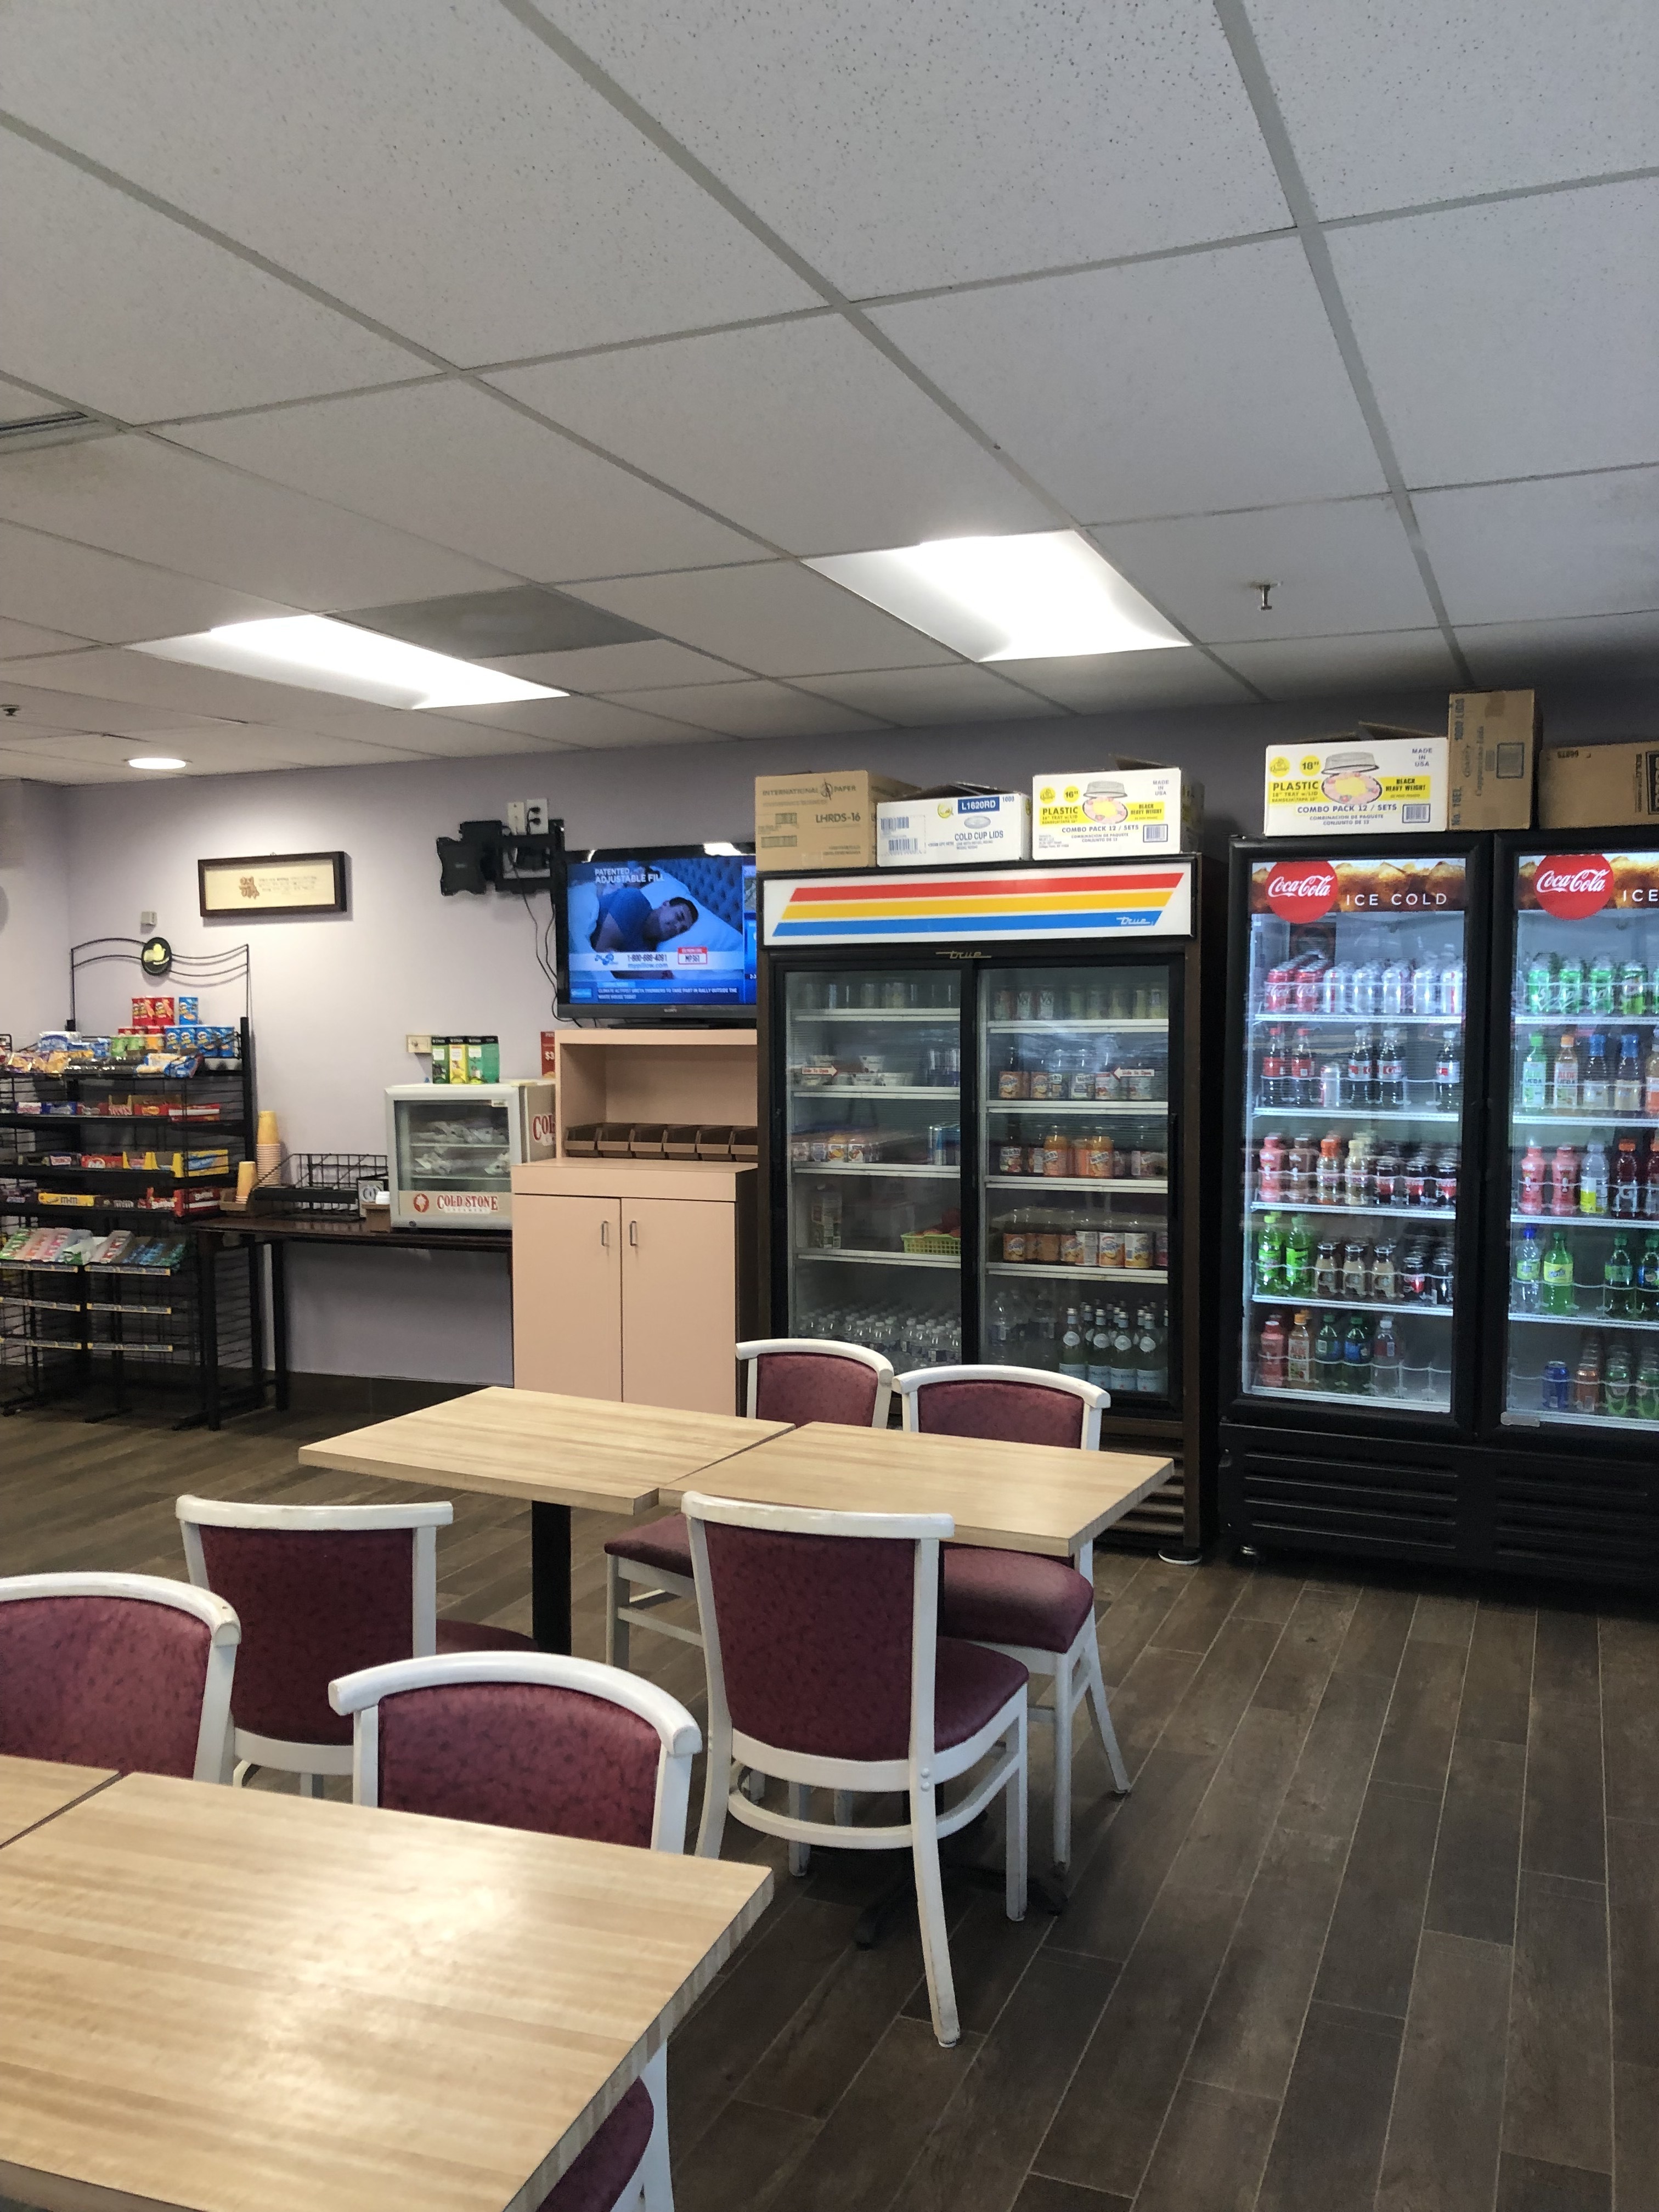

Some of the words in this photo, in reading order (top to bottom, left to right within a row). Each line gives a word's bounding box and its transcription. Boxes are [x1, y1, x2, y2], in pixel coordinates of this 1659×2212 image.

[763, 787, 818, 796] INTERNATIONAL
[1273, 781, 1318, 791] PLASTIC
[1042, 806, 1078, 815] PLASTIC
[815, 812, 861, 823] LHRDS-16
[955, 833, 972, 841] COLD
[989, 831, 1003, 839] LIDS
[594, 867, 630, 876] PATENTED
[595, 874, 646, 884] ADJUSTABLE
[647, 873, 665, 882] FILL
[1536, 869, 1610, 893] Coca-Cola
[1267, 875, 1335, 898] Coca-Cola
[1346, 894, 1379, 906] ICE
[1391, 893, 1447, 906] COLD
[533, 1115, 556, 1141] COL
[437, 1195, 463, 1209] COLD
[465, 1195, 499, 1211] STONE
